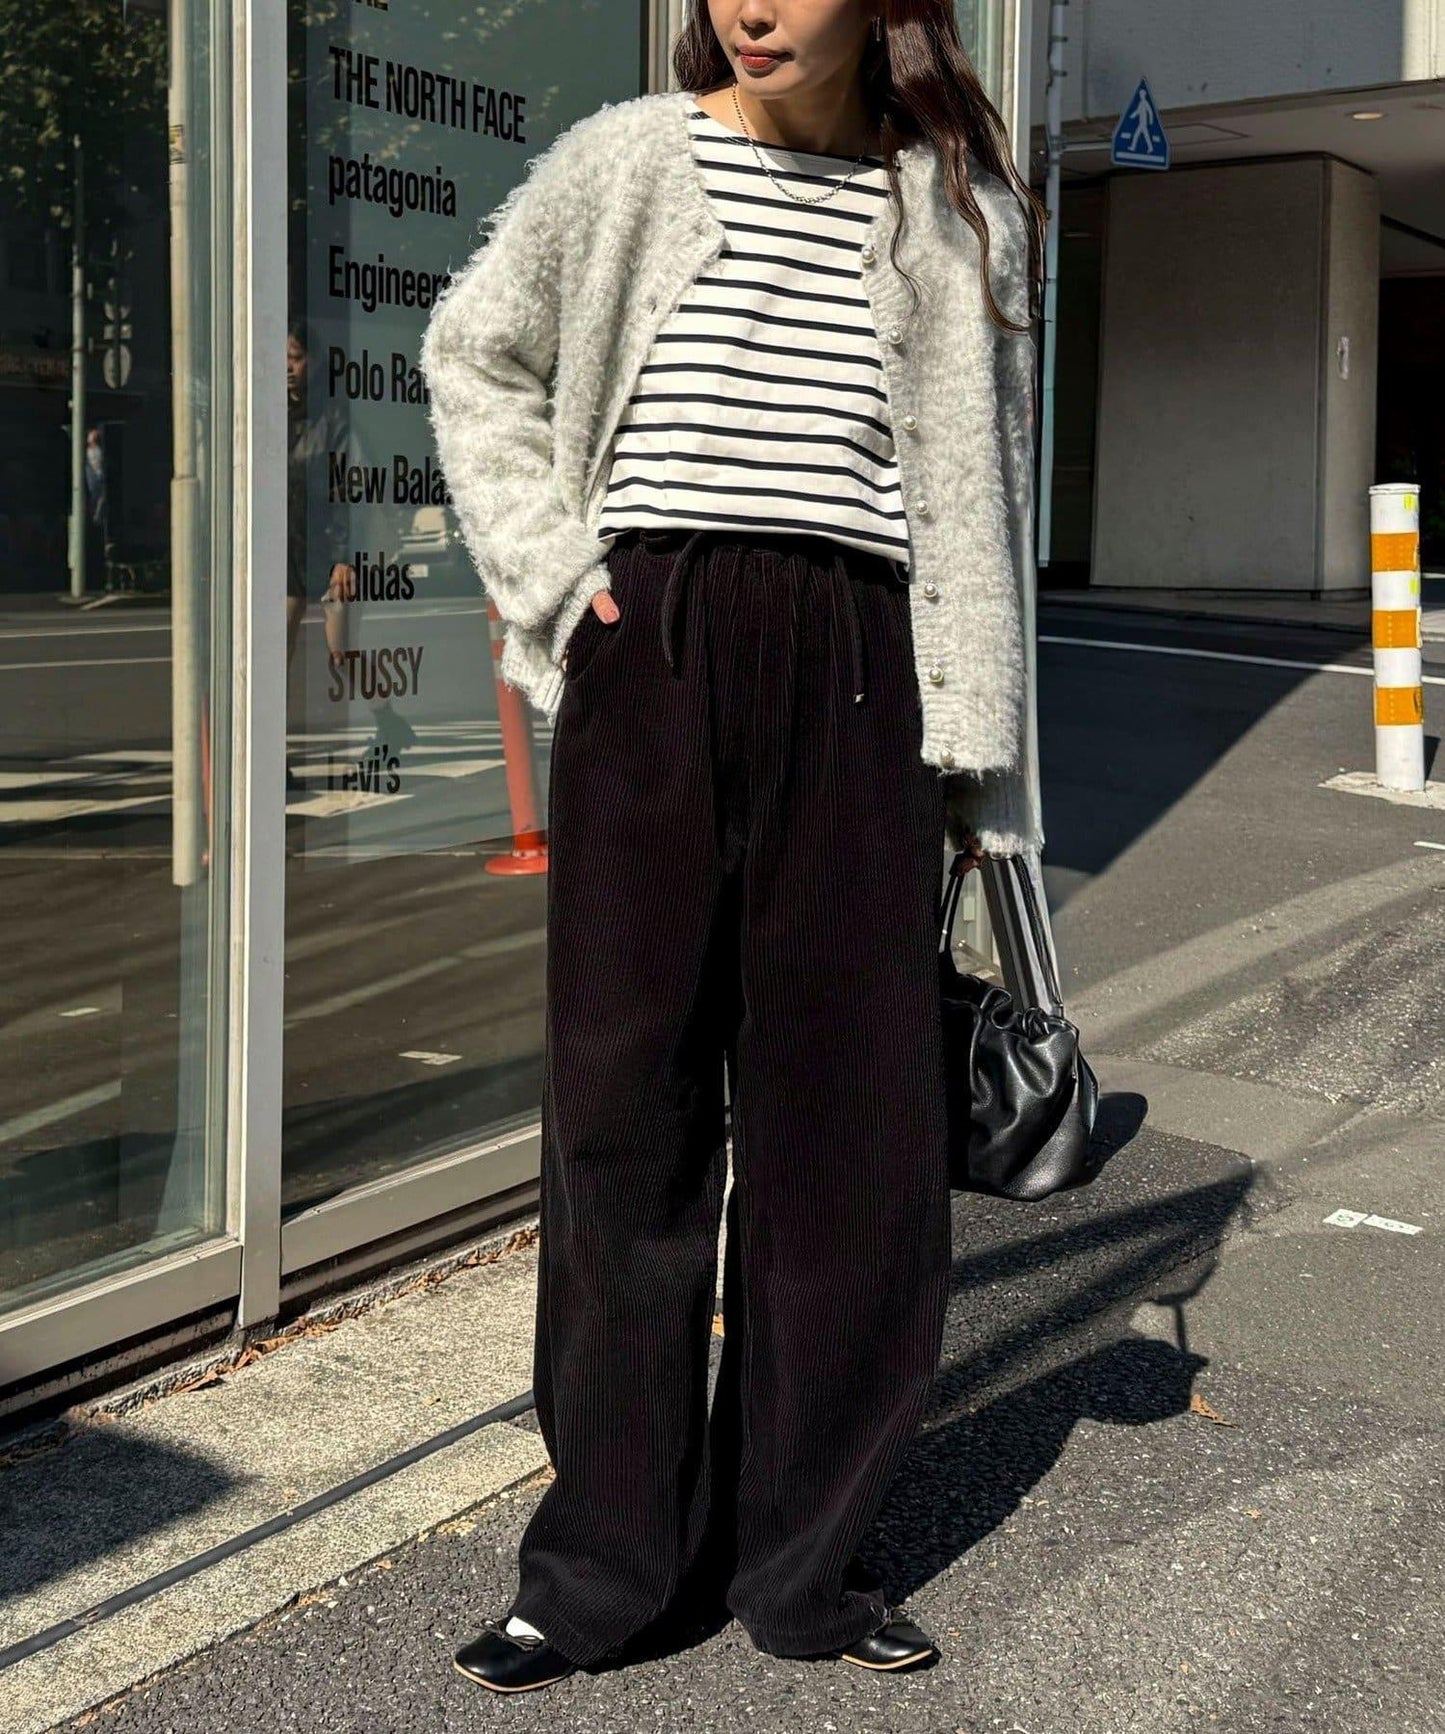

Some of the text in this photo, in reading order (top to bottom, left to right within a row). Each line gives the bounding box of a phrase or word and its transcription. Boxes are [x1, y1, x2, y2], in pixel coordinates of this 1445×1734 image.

[329, 46, 526, 144] THE NORTH FACE
[329, 153, 456, 217] patagonia
[329, 346, 384, 401] Polo
[328, 451, 452, 505] New Bala
[328, 646, 424, 702] STUSSY
